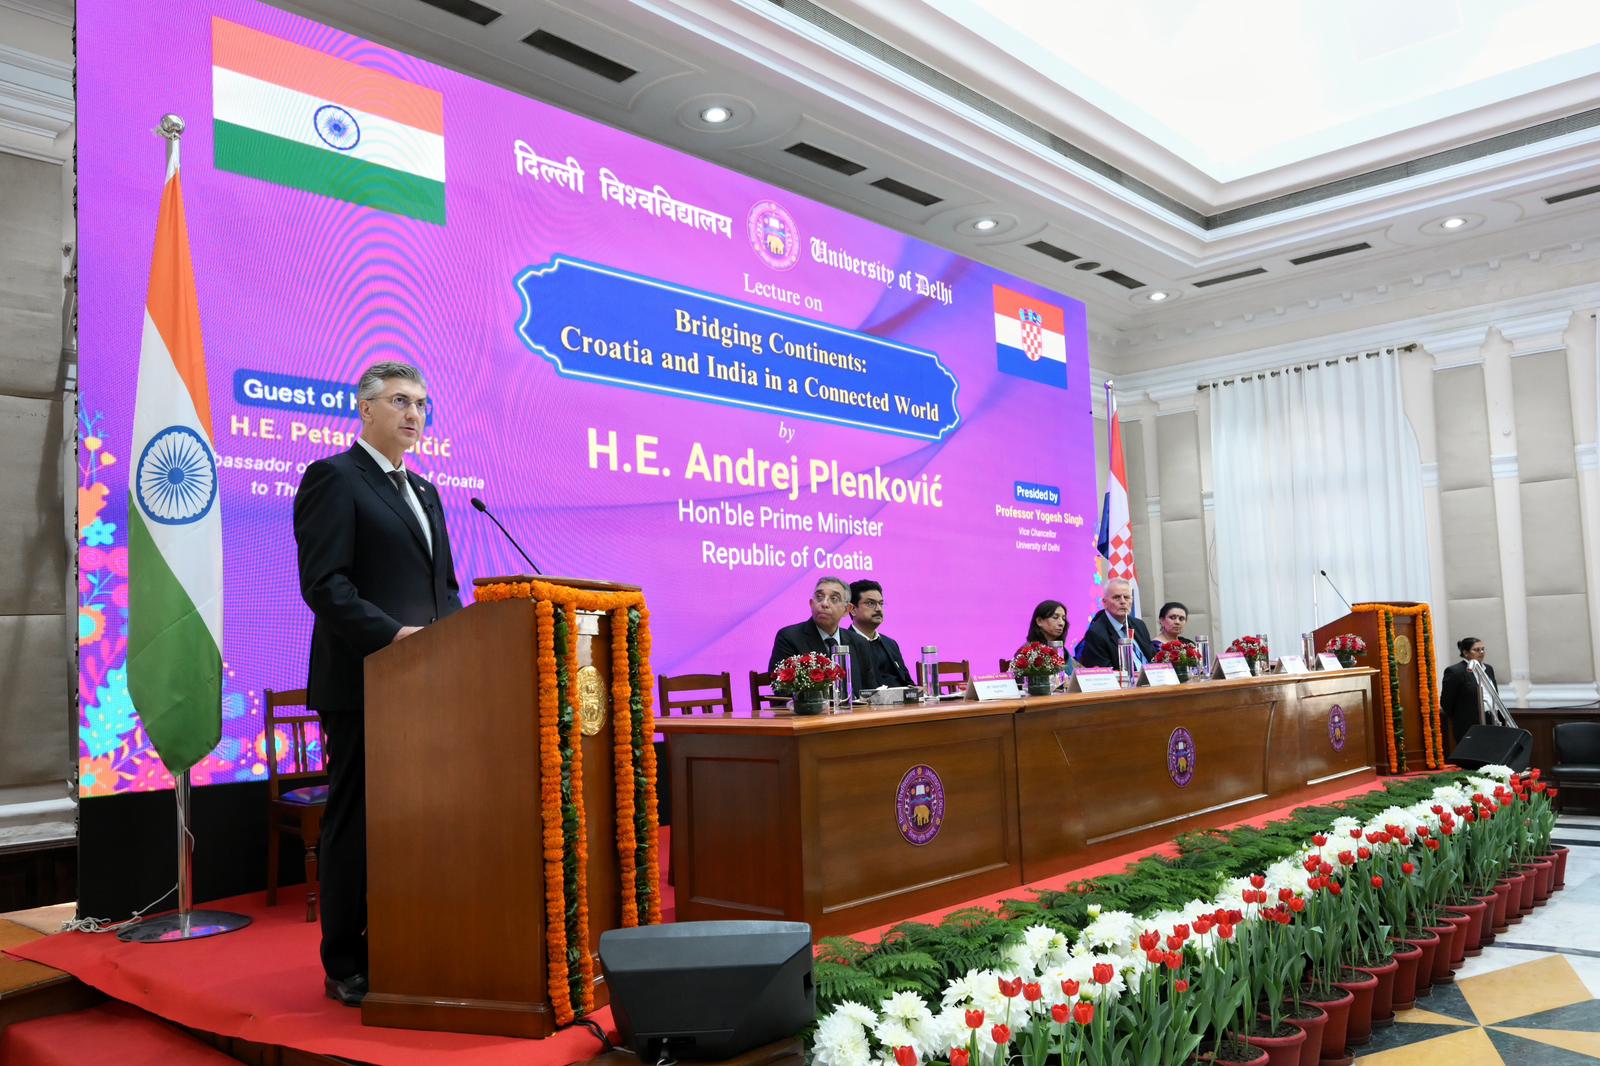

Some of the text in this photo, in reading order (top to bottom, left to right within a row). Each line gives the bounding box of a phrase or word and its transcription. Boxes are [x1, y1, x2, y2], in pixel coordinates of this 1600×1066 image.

[514, 139, 585, 194] दिल्ली
[599, 167, 733, 239] विश्वविद्यालय
[810, 236, 953, 306] University of Delhi
[743, 273, 823, 312] Lecture on
[674, 307, 867, 374] Bridging Continents:
[560, 325, 939, 422] Croatia and India in a Connected World
[243, 378, 316, 406] Guest
[320, 390, 344, 409] of
[230, 415, 281, 440] H.E.
[291, 421, 355, 447] Petar
[778, 421, 796, 443] by
[436, 472, 485, 489] Croatia
[587, 427, 943, 508] H.E. Andrej Plenković
[251, 480, 299, 497] to Th
[1016, 485, 1058, 503] Presided by
[678, 498, 884, 537] Hon'ble Prime Minister
[995, 504, 1084, 528] Professor Yogesh Singh
[1016, 541, 1041, 552] University
[1048, 543, 1060, 552] Delhi
[1018, 527, 1057, 538] Vice Chancellor
[702, 540, 873, 571] Republic of Croatia
